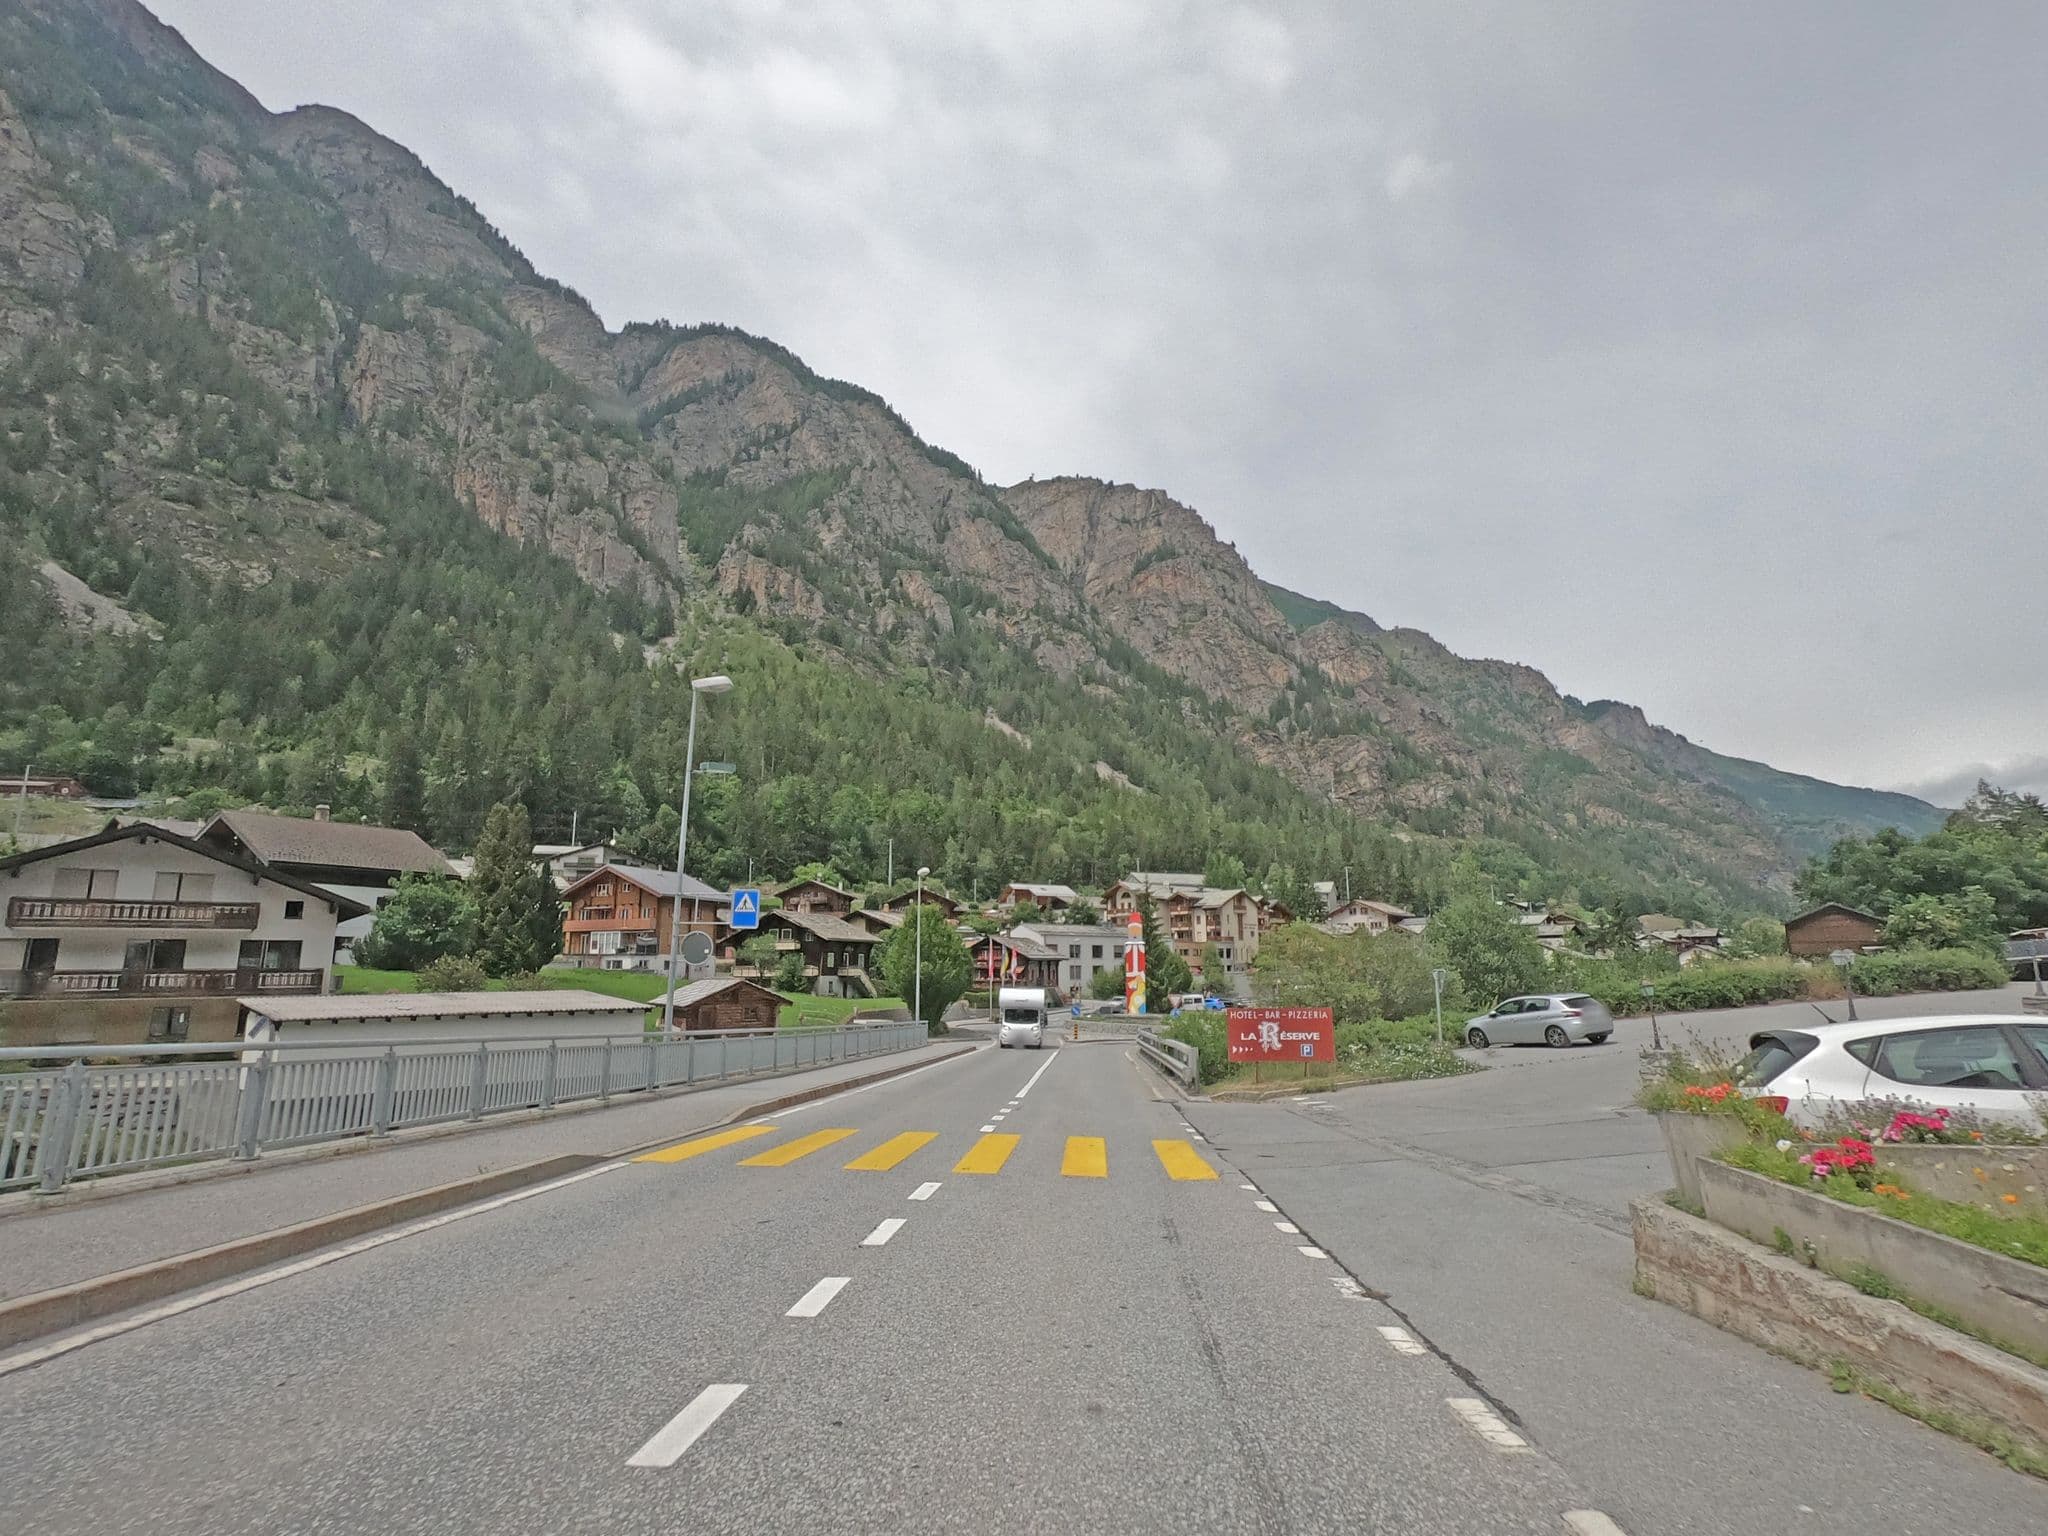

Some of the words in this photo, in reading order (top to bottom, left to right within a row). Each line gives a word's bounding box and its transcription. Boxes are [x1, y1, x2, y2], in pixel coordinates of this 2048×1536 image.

[1230, 1010, 1257, 1019] HOTEL
[1265, 1010, 1280, 1019] BAR
[1288, 1010, 1328, 1019] PIZZERIA
[1240, 1032, 1257, 1040] LA
